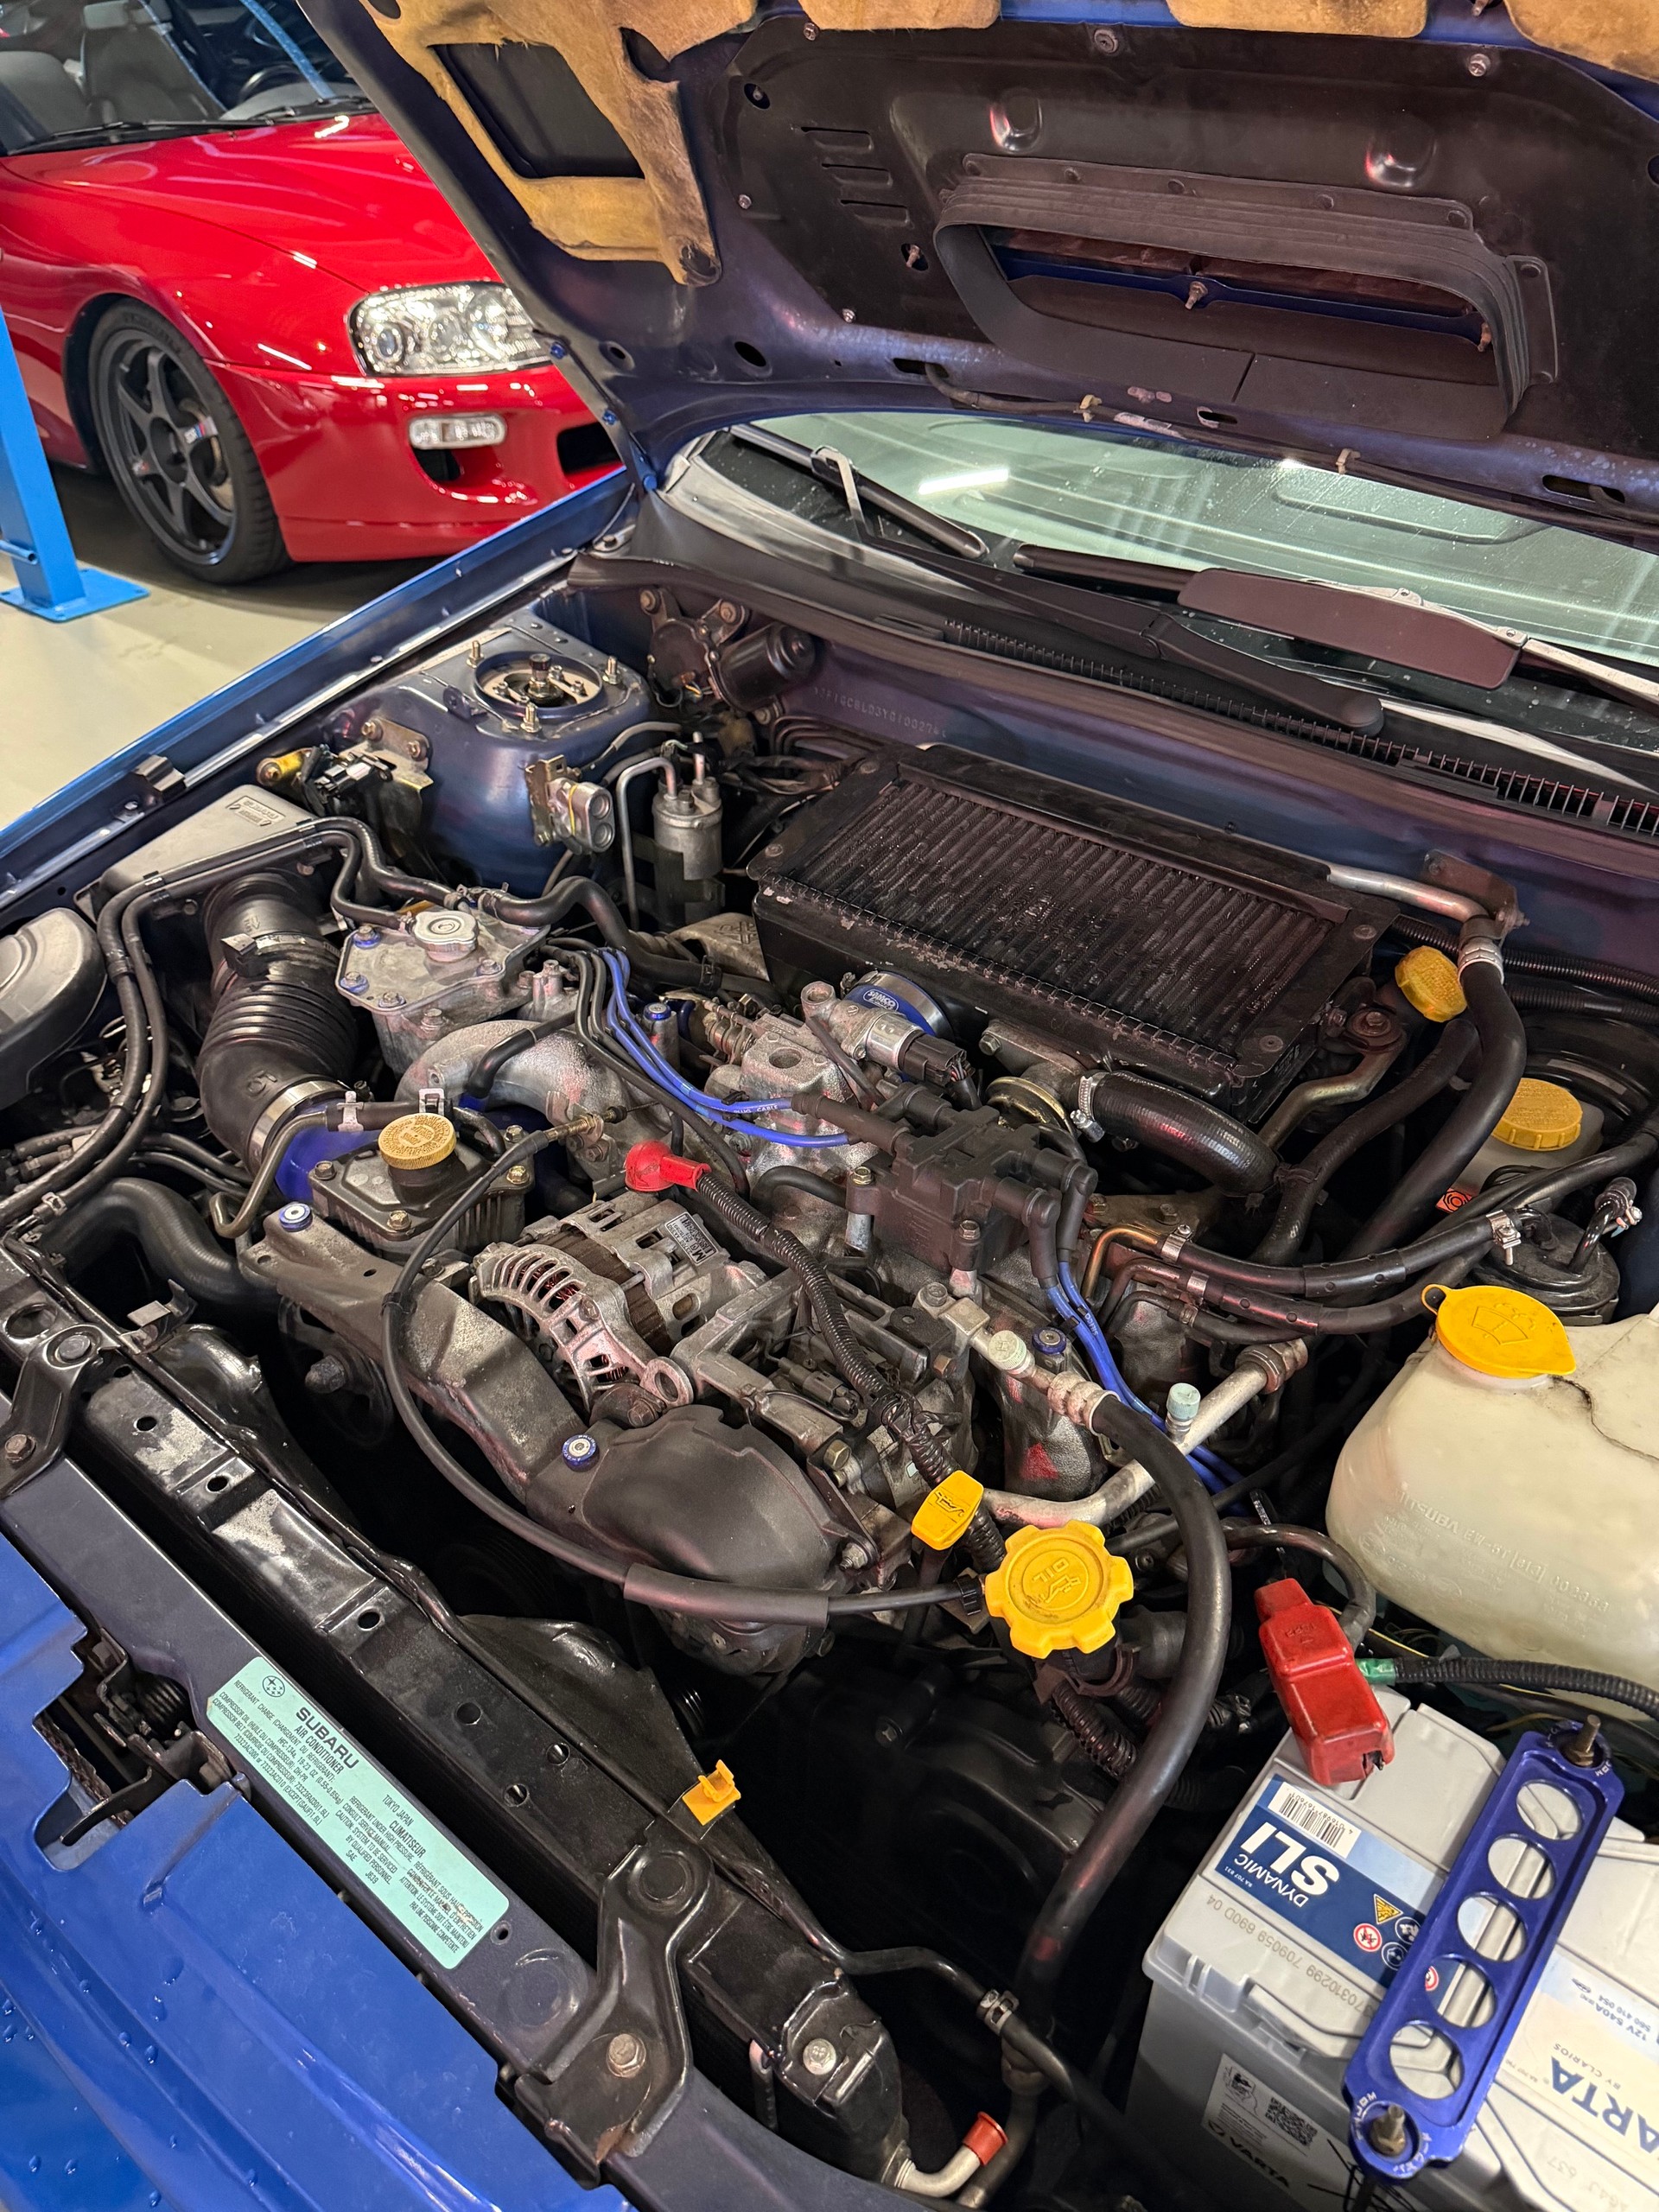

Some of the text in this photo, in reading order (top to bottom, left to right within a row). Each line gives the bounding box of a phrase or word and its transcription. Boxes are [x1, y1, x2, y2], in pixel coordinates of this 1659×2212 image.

[867, 989, 898, 1007] SAMCO
[757, 1103, 779, 1114] CABLE
[1032, 1557, 1071, 1584] OIL
[211, 1696, 238, 1724] COMPRESSOR
[233, 1719, 246, 1732] BELT
[241, 1727, 264, 1751] (COURROIE
[259, 1746, 270, 1757] DU
[232, 1678, 260, 1706] REFRIGERANT
[256, 1701, 275, 1721] CHARGE
[271, 1717, 302, 1748] (CHARGEMENT
[298, 1744, 309, 1755] DU
[218, 1690, 245, 1718] COMPRESSOR
[240, 1713, 251, 1724] OIL
[246, 1719, 263, 1736] (HUILE
[257, 1731, 269, 1741] DU
[292, 1765, 308, 1783] DH-PR
[293, 1723, 345, 1775] AIR CONDITIONER
[294, 1705, 359, 1770] SUBARU
[232, 1732, 259, 1760] 73323AC000
[259, 1759, 287, 1789] 73323AC010
[296, 1756, 311, 1771] 19-23
[308, 1768, 318, 1778] OZ
[340, 1801, 362, 1823] CONSULT
[357, 1817, 377, 1838] SERVICE
[347, 1794, 376, 1823] REFRIGERANT
[371, 1817, 388, 1834] UNDER
[383, 1829, 397, 1844] HIGH
[380, 1793, 415, 1827] TOKYO JAPAN
[334, 1808, 398, 1875] CAUTION: SYSTEM TO BE SERVICED
[344, 1834, 355, 1845] BY
[350, 1839, 372, 1863] QUALIFIED
[387, 1818, 427, 1859] CLIMATISEUR
[345, 1848, 379, 1885] SAE J639
[1239, 1821, 1343, 1900] SLI
[427, 1888, 436, 1899] LE
[436, 1884, 453, 1901] SOUS
[1231, 1850, 1309, 1909] DYNAMIC
[408, 1899, 419, 1911] PAR
[414, 1906, 426, 1918] UNE
[420, 1912, 441, 1934] PERSONNE
[1205, 1892, 1224, 1911] 04
[433, 1910, 446, 1923] DOIT
[448, 1926, 470, 1948] MAINTENU
[1594, 2002, 1624, 2026] 540A
[1625, 2024, 1648, 2042] 12V
[1553, 2042, 1622, 2091] BY CLARIOS
[1551, 2055, 1659, 2155] ARTA
